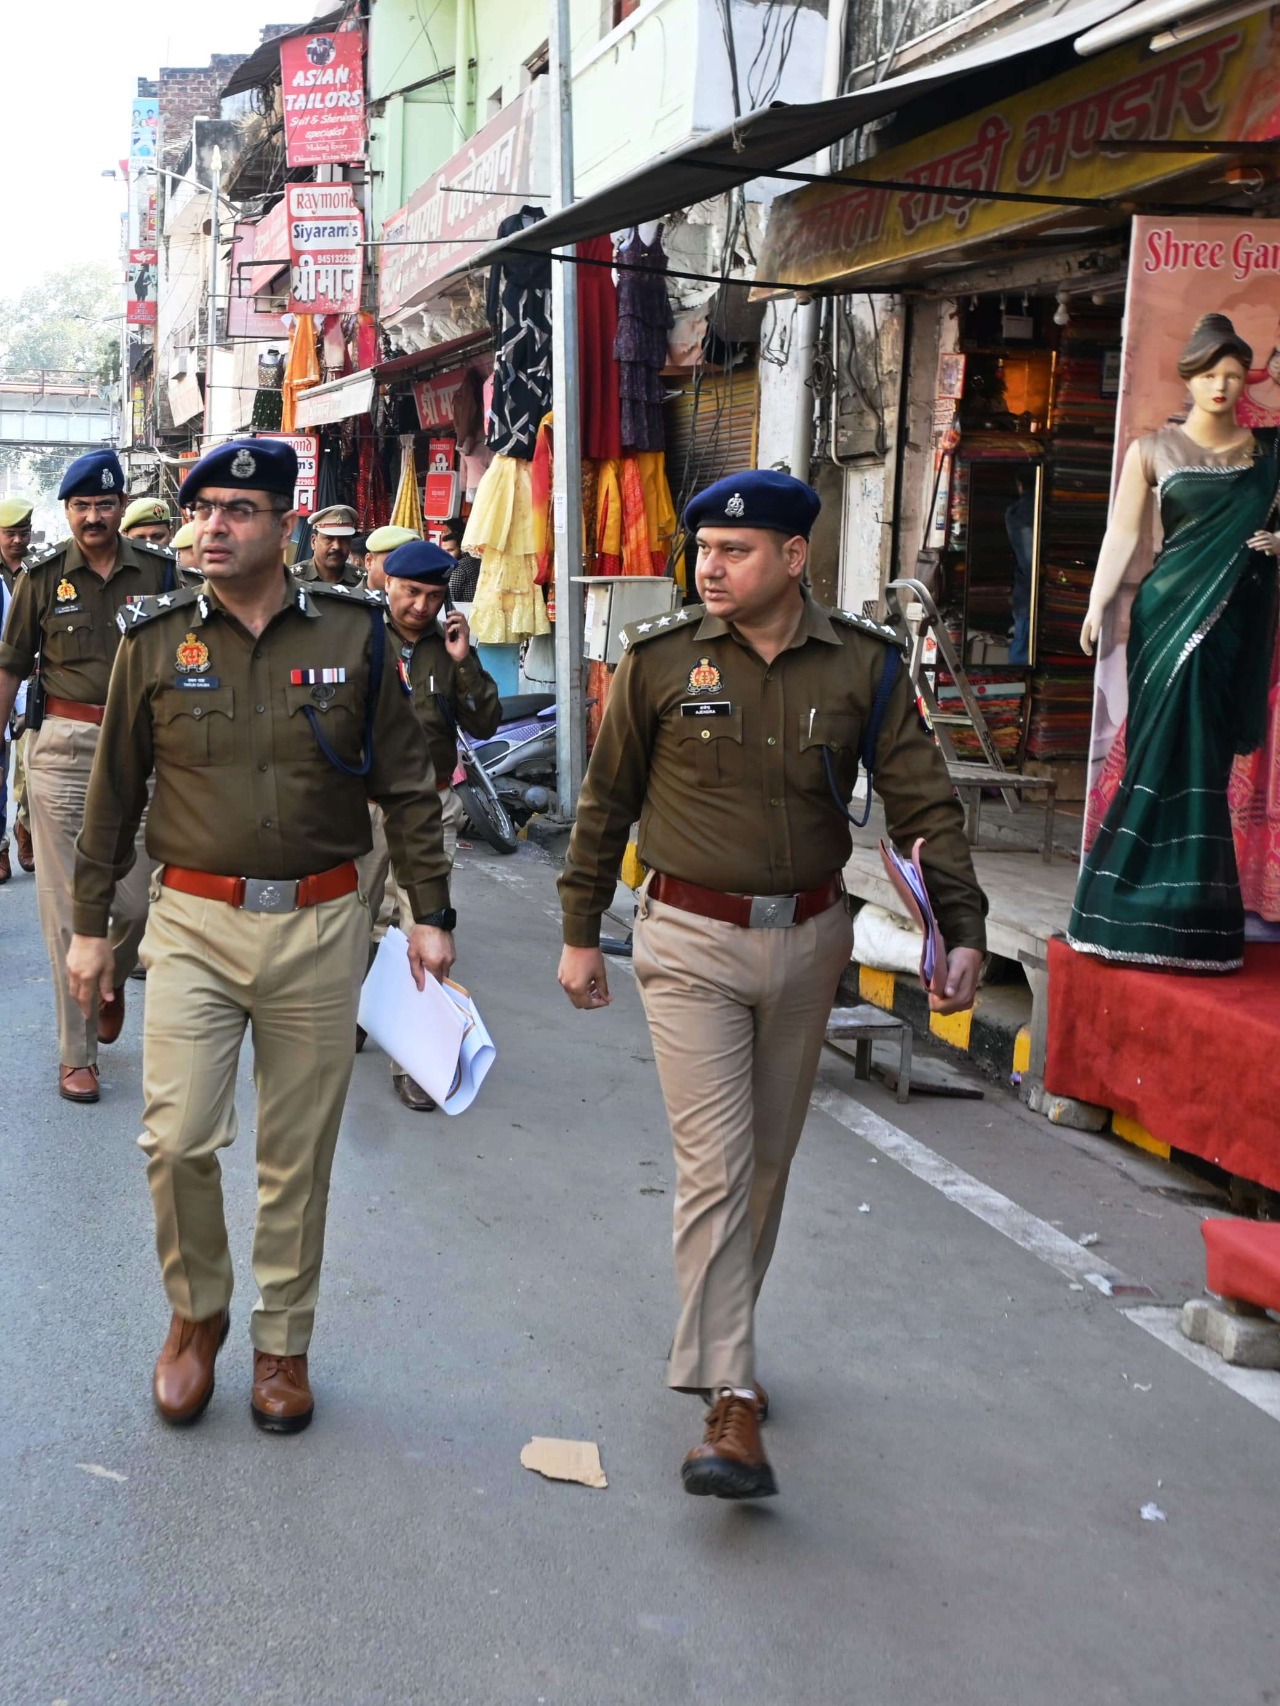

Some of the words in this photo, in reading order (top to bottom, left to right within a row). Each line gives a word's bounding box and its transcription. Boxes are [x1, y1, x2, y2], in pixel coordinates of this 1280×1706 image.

[292, 67, 349, 87] ASIAN
[285, 90, 362, 111] TAILORS
[293, 222, 359, 242] Siyaram's
[1144, 229, 1225, 273] Shree
